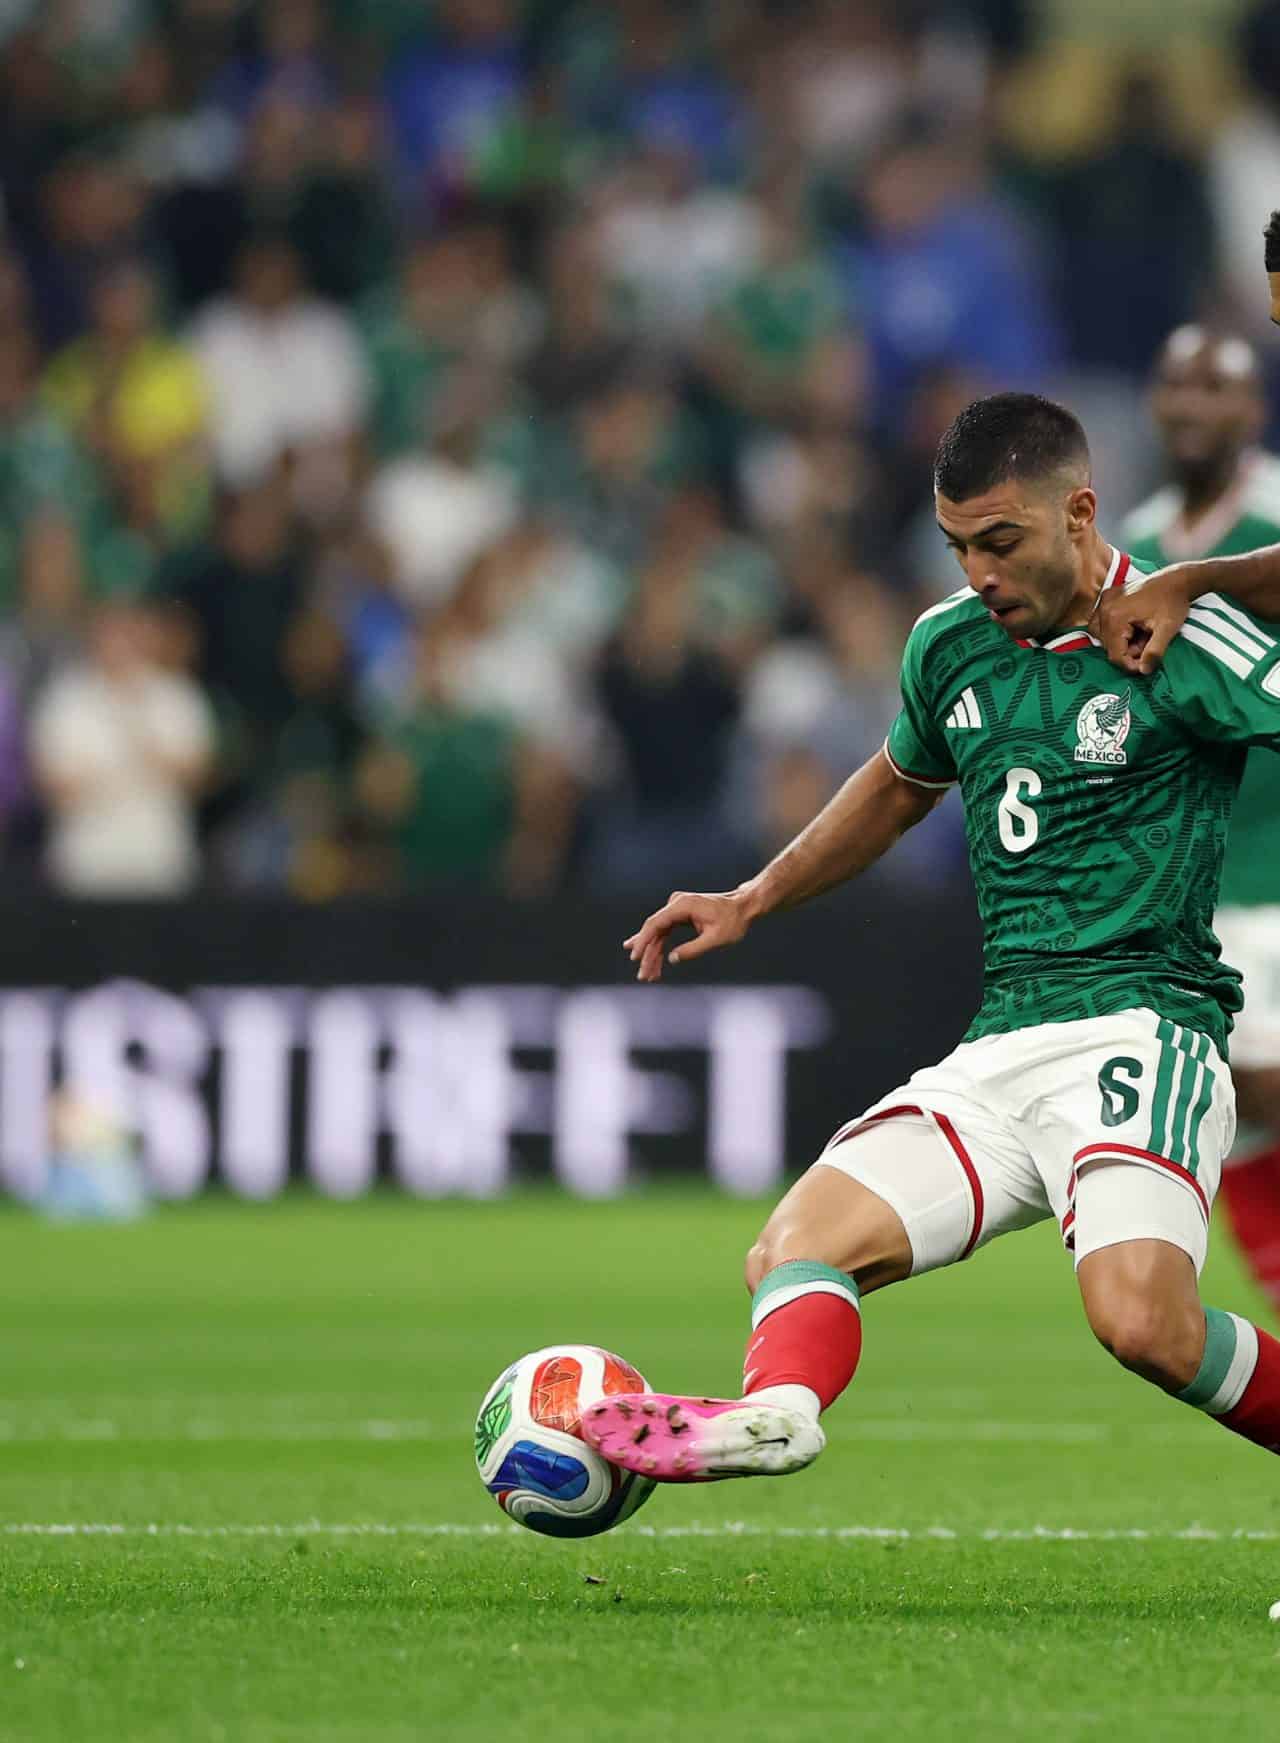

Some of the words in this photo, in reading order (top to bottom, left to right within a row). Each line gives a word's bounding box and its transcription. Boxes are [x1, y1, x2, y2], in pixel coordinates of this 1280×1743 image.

[1076, 749, 1126, 763] MEXICO
[998, 767, 1042, 853] 6
[1098, 1056, 1144, 1127] 6
